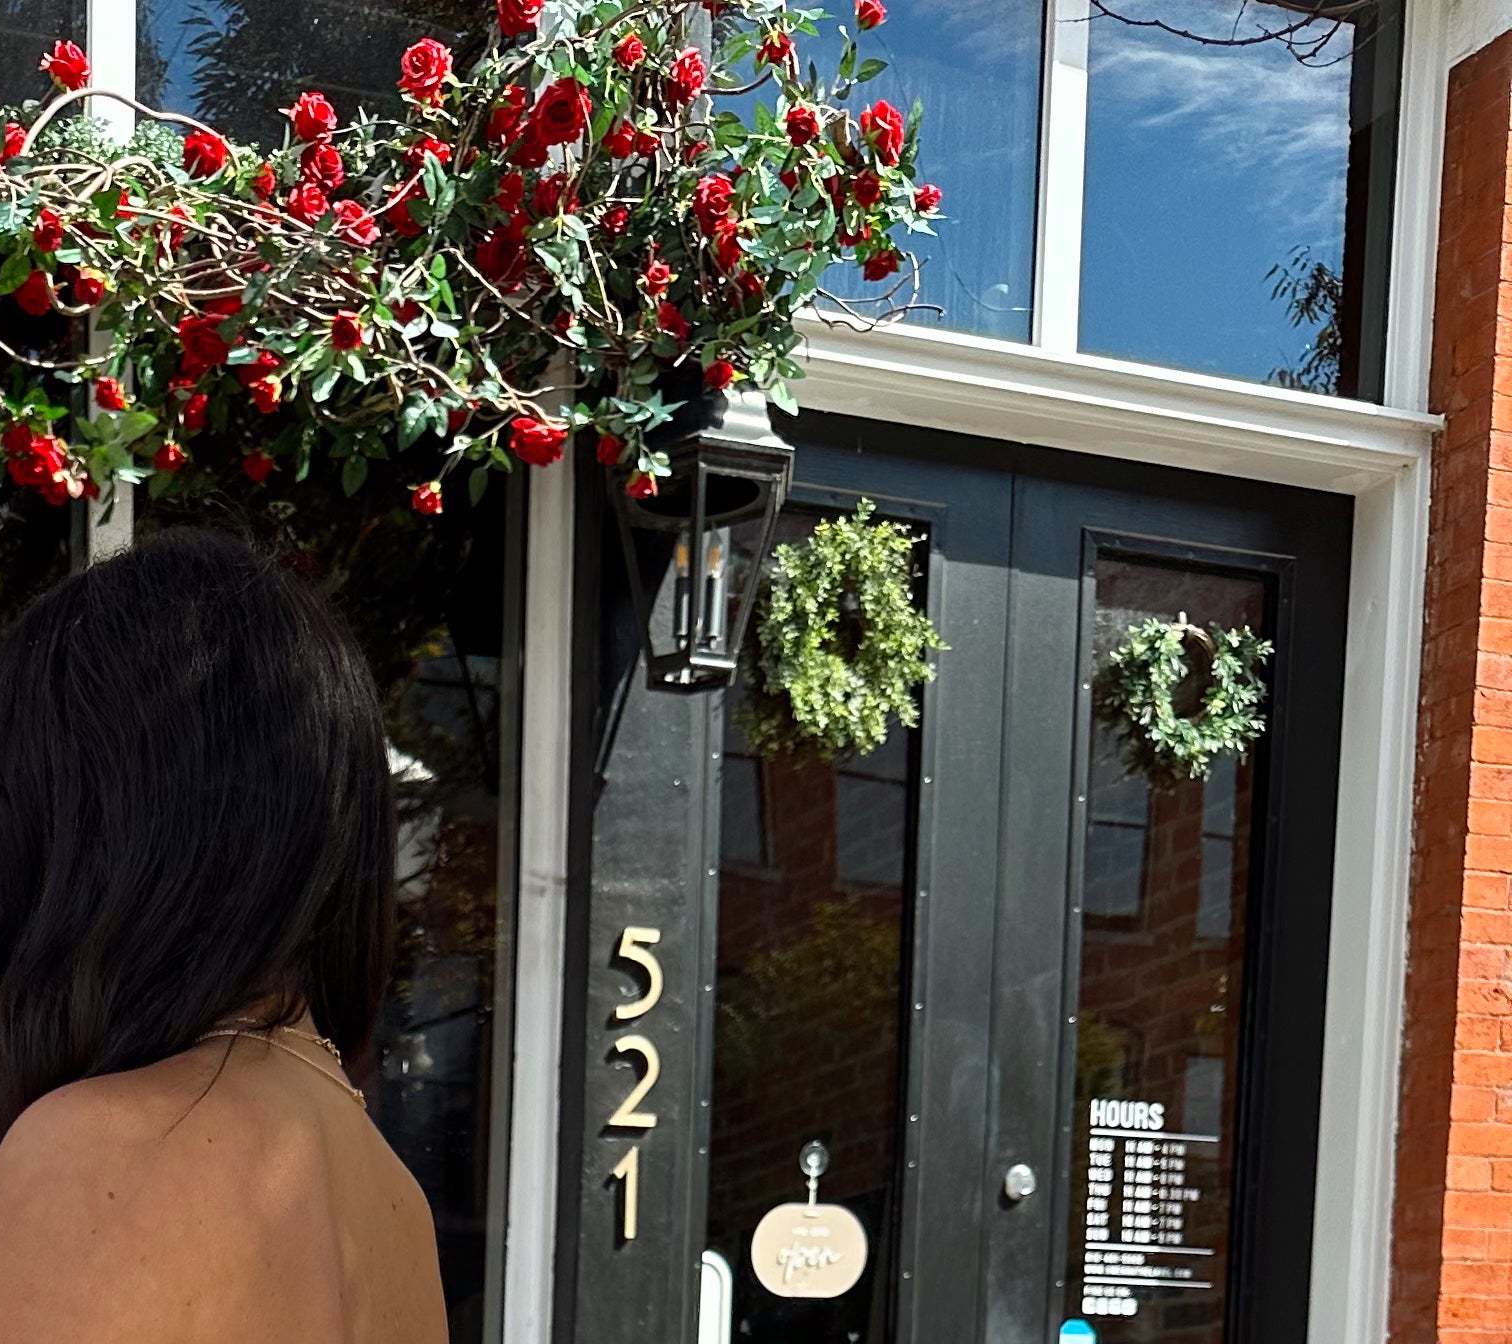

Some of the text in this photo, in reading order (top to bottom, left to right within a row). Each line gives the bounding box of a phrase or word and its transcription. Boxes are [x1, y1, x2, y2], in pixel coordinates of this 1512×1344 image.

[609, 926, 664, 1240] 521
[1090, 1098, 1165, 1131] HOURS
[1089, 1152, 1113, 1167] TUE
[1086, 1212, 1110, 1226] SAT
[777, 1240, 842, 1283] open
